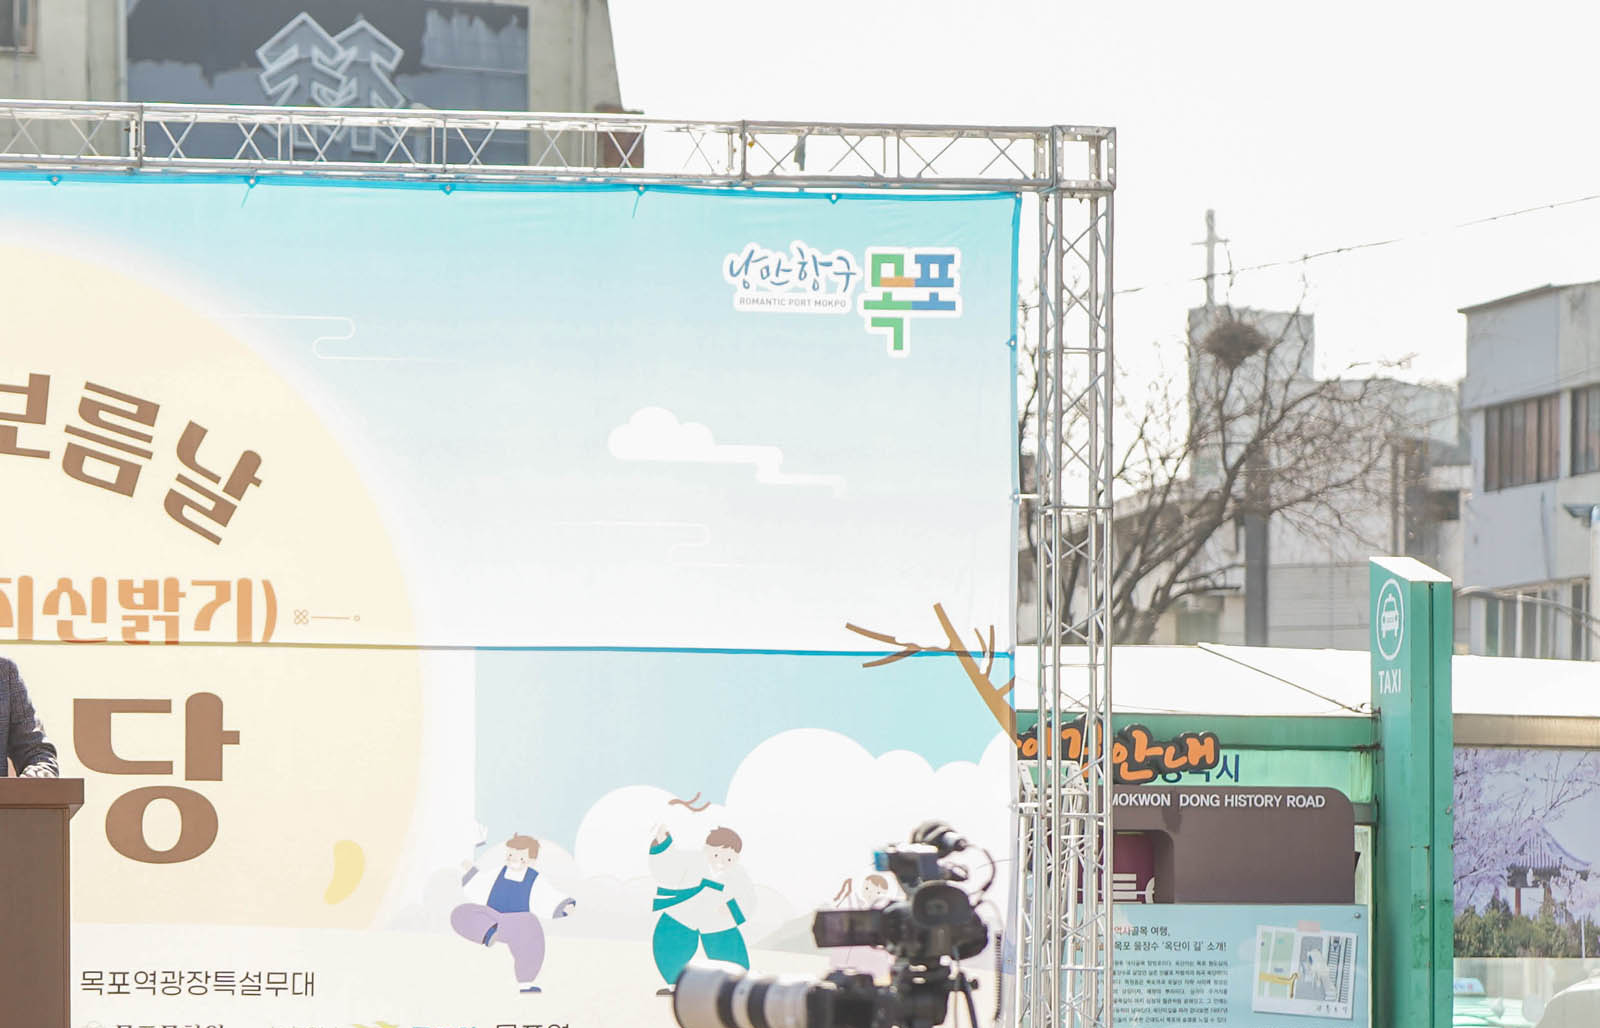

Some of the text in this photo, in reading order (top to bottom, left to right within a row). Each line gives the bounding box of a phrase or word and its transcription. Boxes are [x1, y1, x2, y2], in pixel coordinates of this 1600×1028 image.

[729, 246, 857, 293] 낭만항구
[739, 296, 847, 308] ROMANTIC PORT MOKPO
[863, 253, 957, 351] 목포
[1378, 668, 1402, 695] TAXI
[1179, 794, 1221, 808] DONG
[1224, 794, 1282, 808] HISTORY
[1286, 795, 1326, 808] ROAD
[80, 970, 315, 997] 목포역광장특설무대
